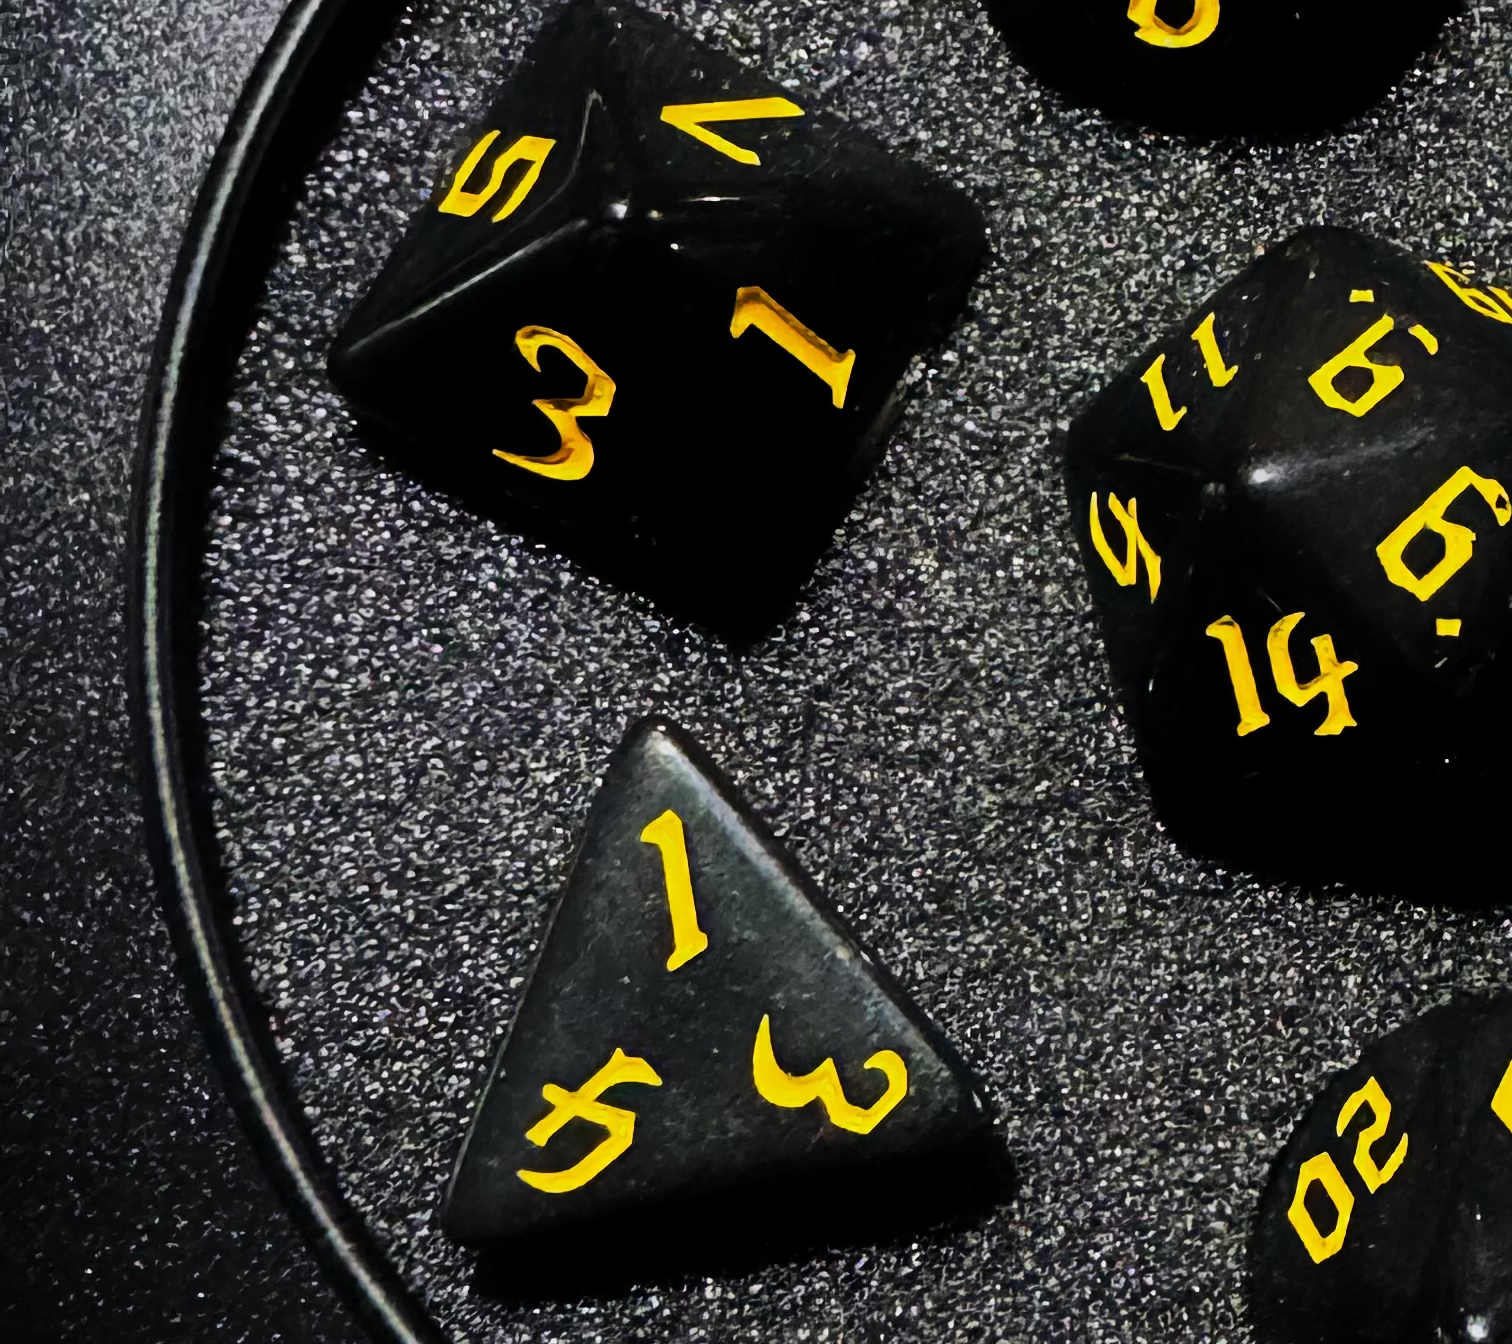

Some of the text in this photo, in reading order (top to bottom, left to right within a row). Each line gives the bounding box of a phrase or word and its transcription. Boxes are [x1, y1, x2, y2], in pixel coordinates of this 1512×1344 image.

[438, 130, 556, 222] 5
[492, 325, 616, 480] 3
[730, 286, 856, 409] 1
[1206, 612, 1358, 736] 14
[640, 809, 708, 971] 1
[517, 1048, 662, 1193] 4
[753, 1014, 907, 1134] 3
[1288, 1077, 1408, 1264] 20
